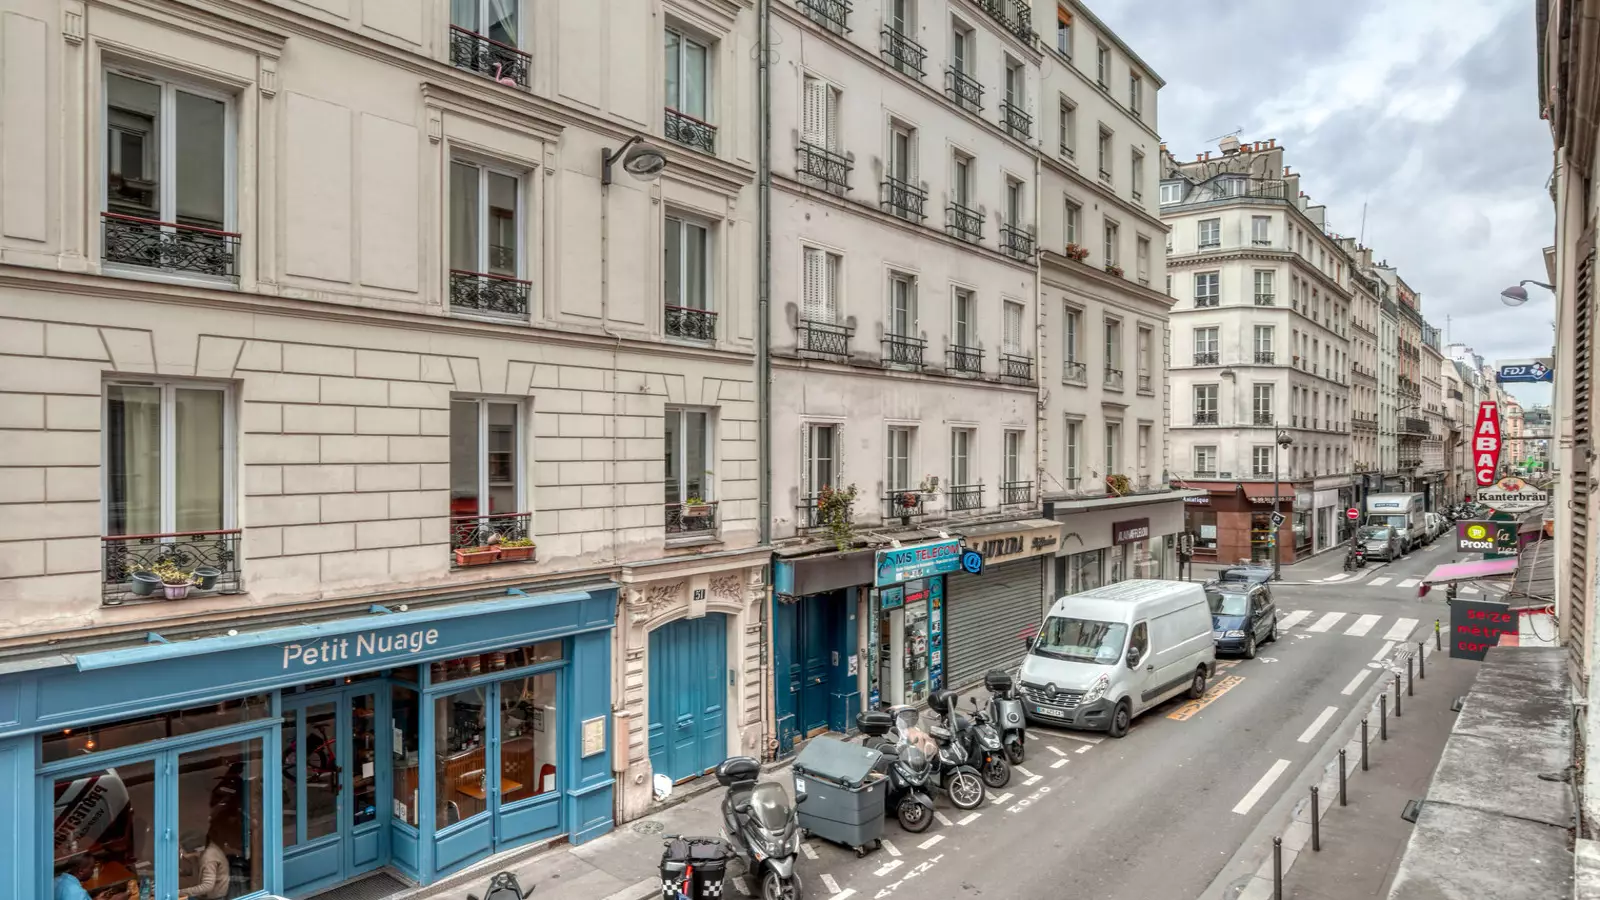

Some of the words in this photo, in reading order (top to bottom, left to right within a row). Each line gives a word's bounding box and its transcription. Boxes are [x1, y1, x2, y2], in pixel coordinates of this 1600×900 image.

[1503, 366, 1526, 375] FDJ
[1475, 404, 1497, 483] TABAC
[1478, 492, 1546, 501] Kanterbräu
[1460, 538, 1494, 549] Proxi
[895, 552, 912, 564] MS
[915, 543, 959, 560] TELECOM
[694, 589, 704, 600] 51
[1467, 609, 1511, 623] seize
[282, 638, 349, 669] Petit
[356, 628, 439, 656] Nuage
